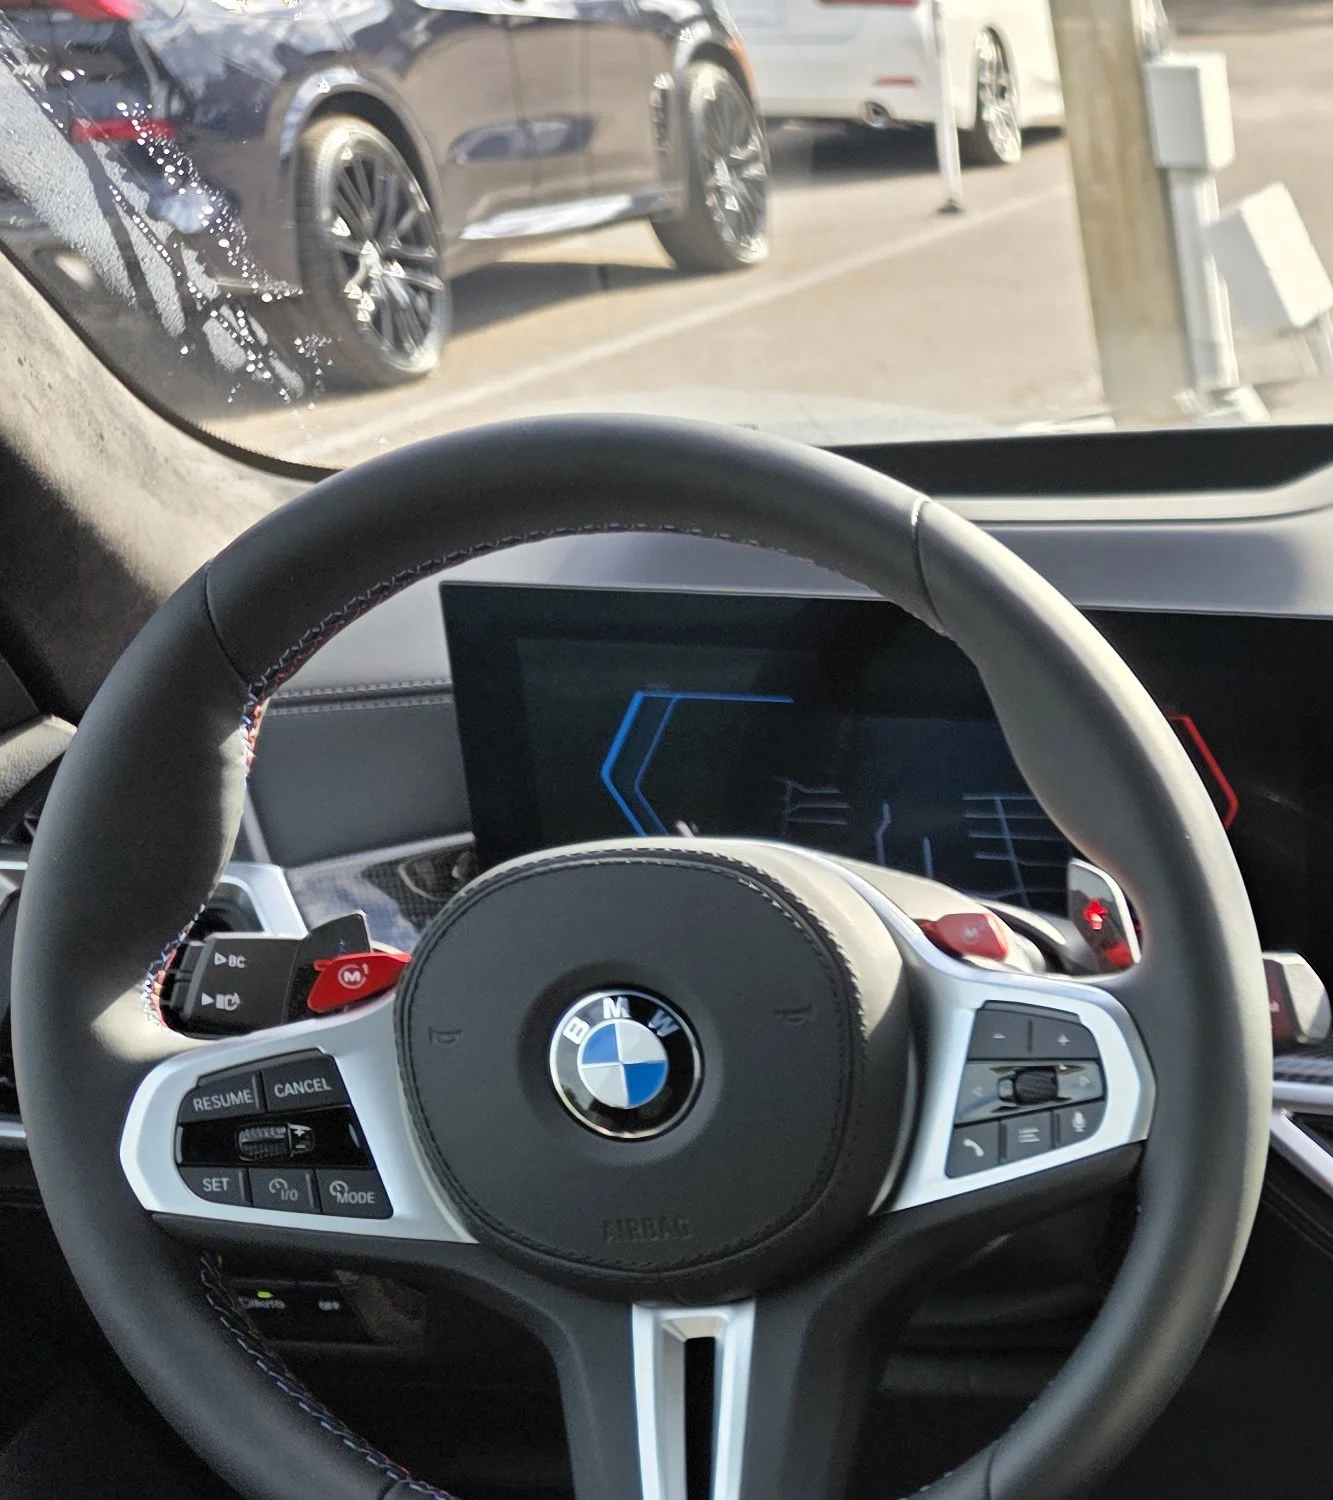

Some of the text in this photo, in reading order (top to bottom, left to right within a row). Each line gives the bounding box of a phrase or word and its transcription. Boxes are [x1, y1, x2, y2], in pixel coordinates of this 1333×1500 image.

[563, 997, 680, 1045] BMW
[274, 1077, 333, 1098] CANCEL
[193, 1089, 254, 1112] RESUME
[203, 1177, 230, 1192] SET
[336, 1191, 376, 1205] MODE
